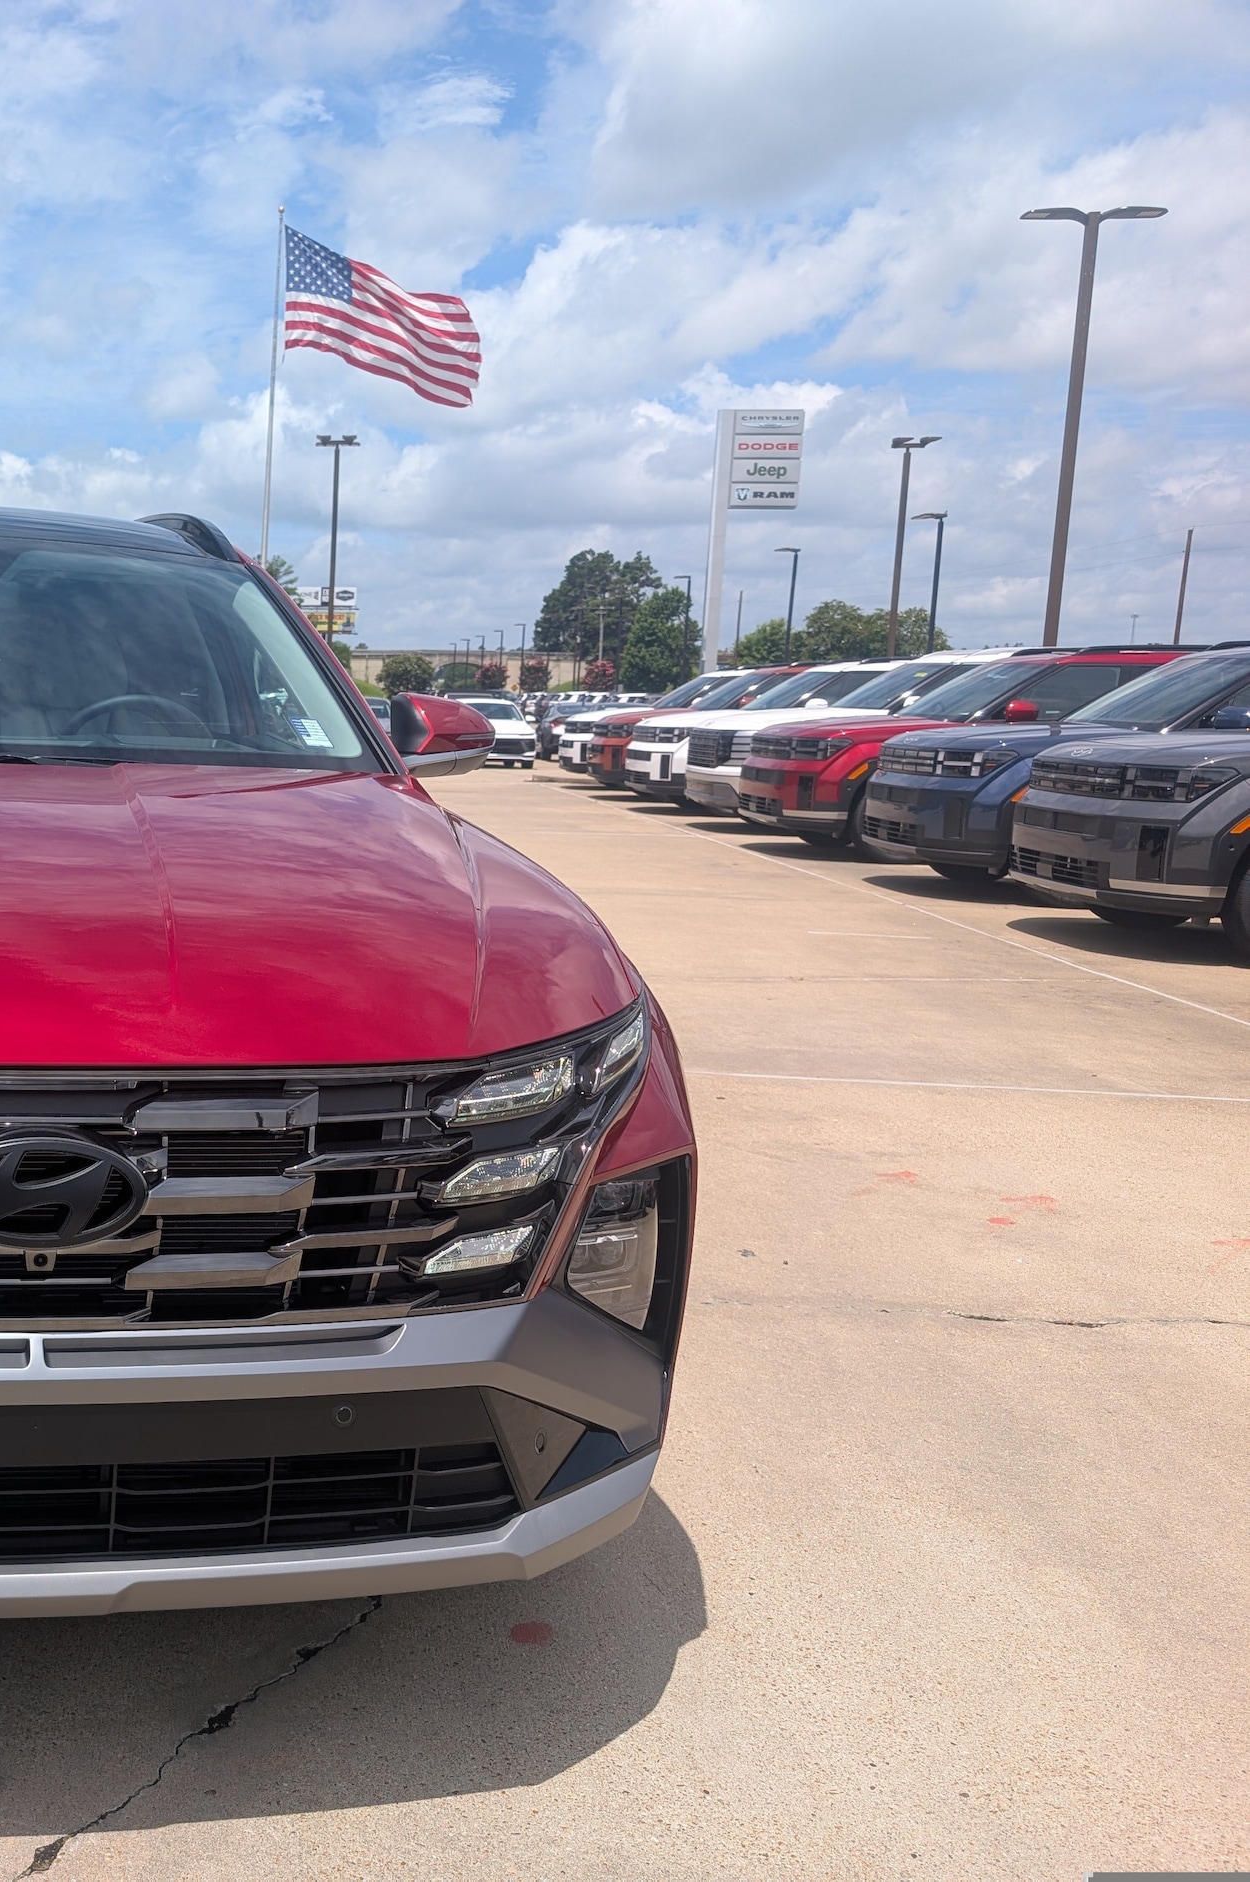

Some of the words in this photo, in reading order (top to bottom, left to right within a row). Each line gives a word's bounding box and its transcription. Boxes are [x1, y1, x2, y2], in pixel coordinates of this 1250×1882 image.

[738, 443, 799, 451] DODGE
[746, 462, 788, 479] Jeep
[752, 491, 795, 499] RAM
